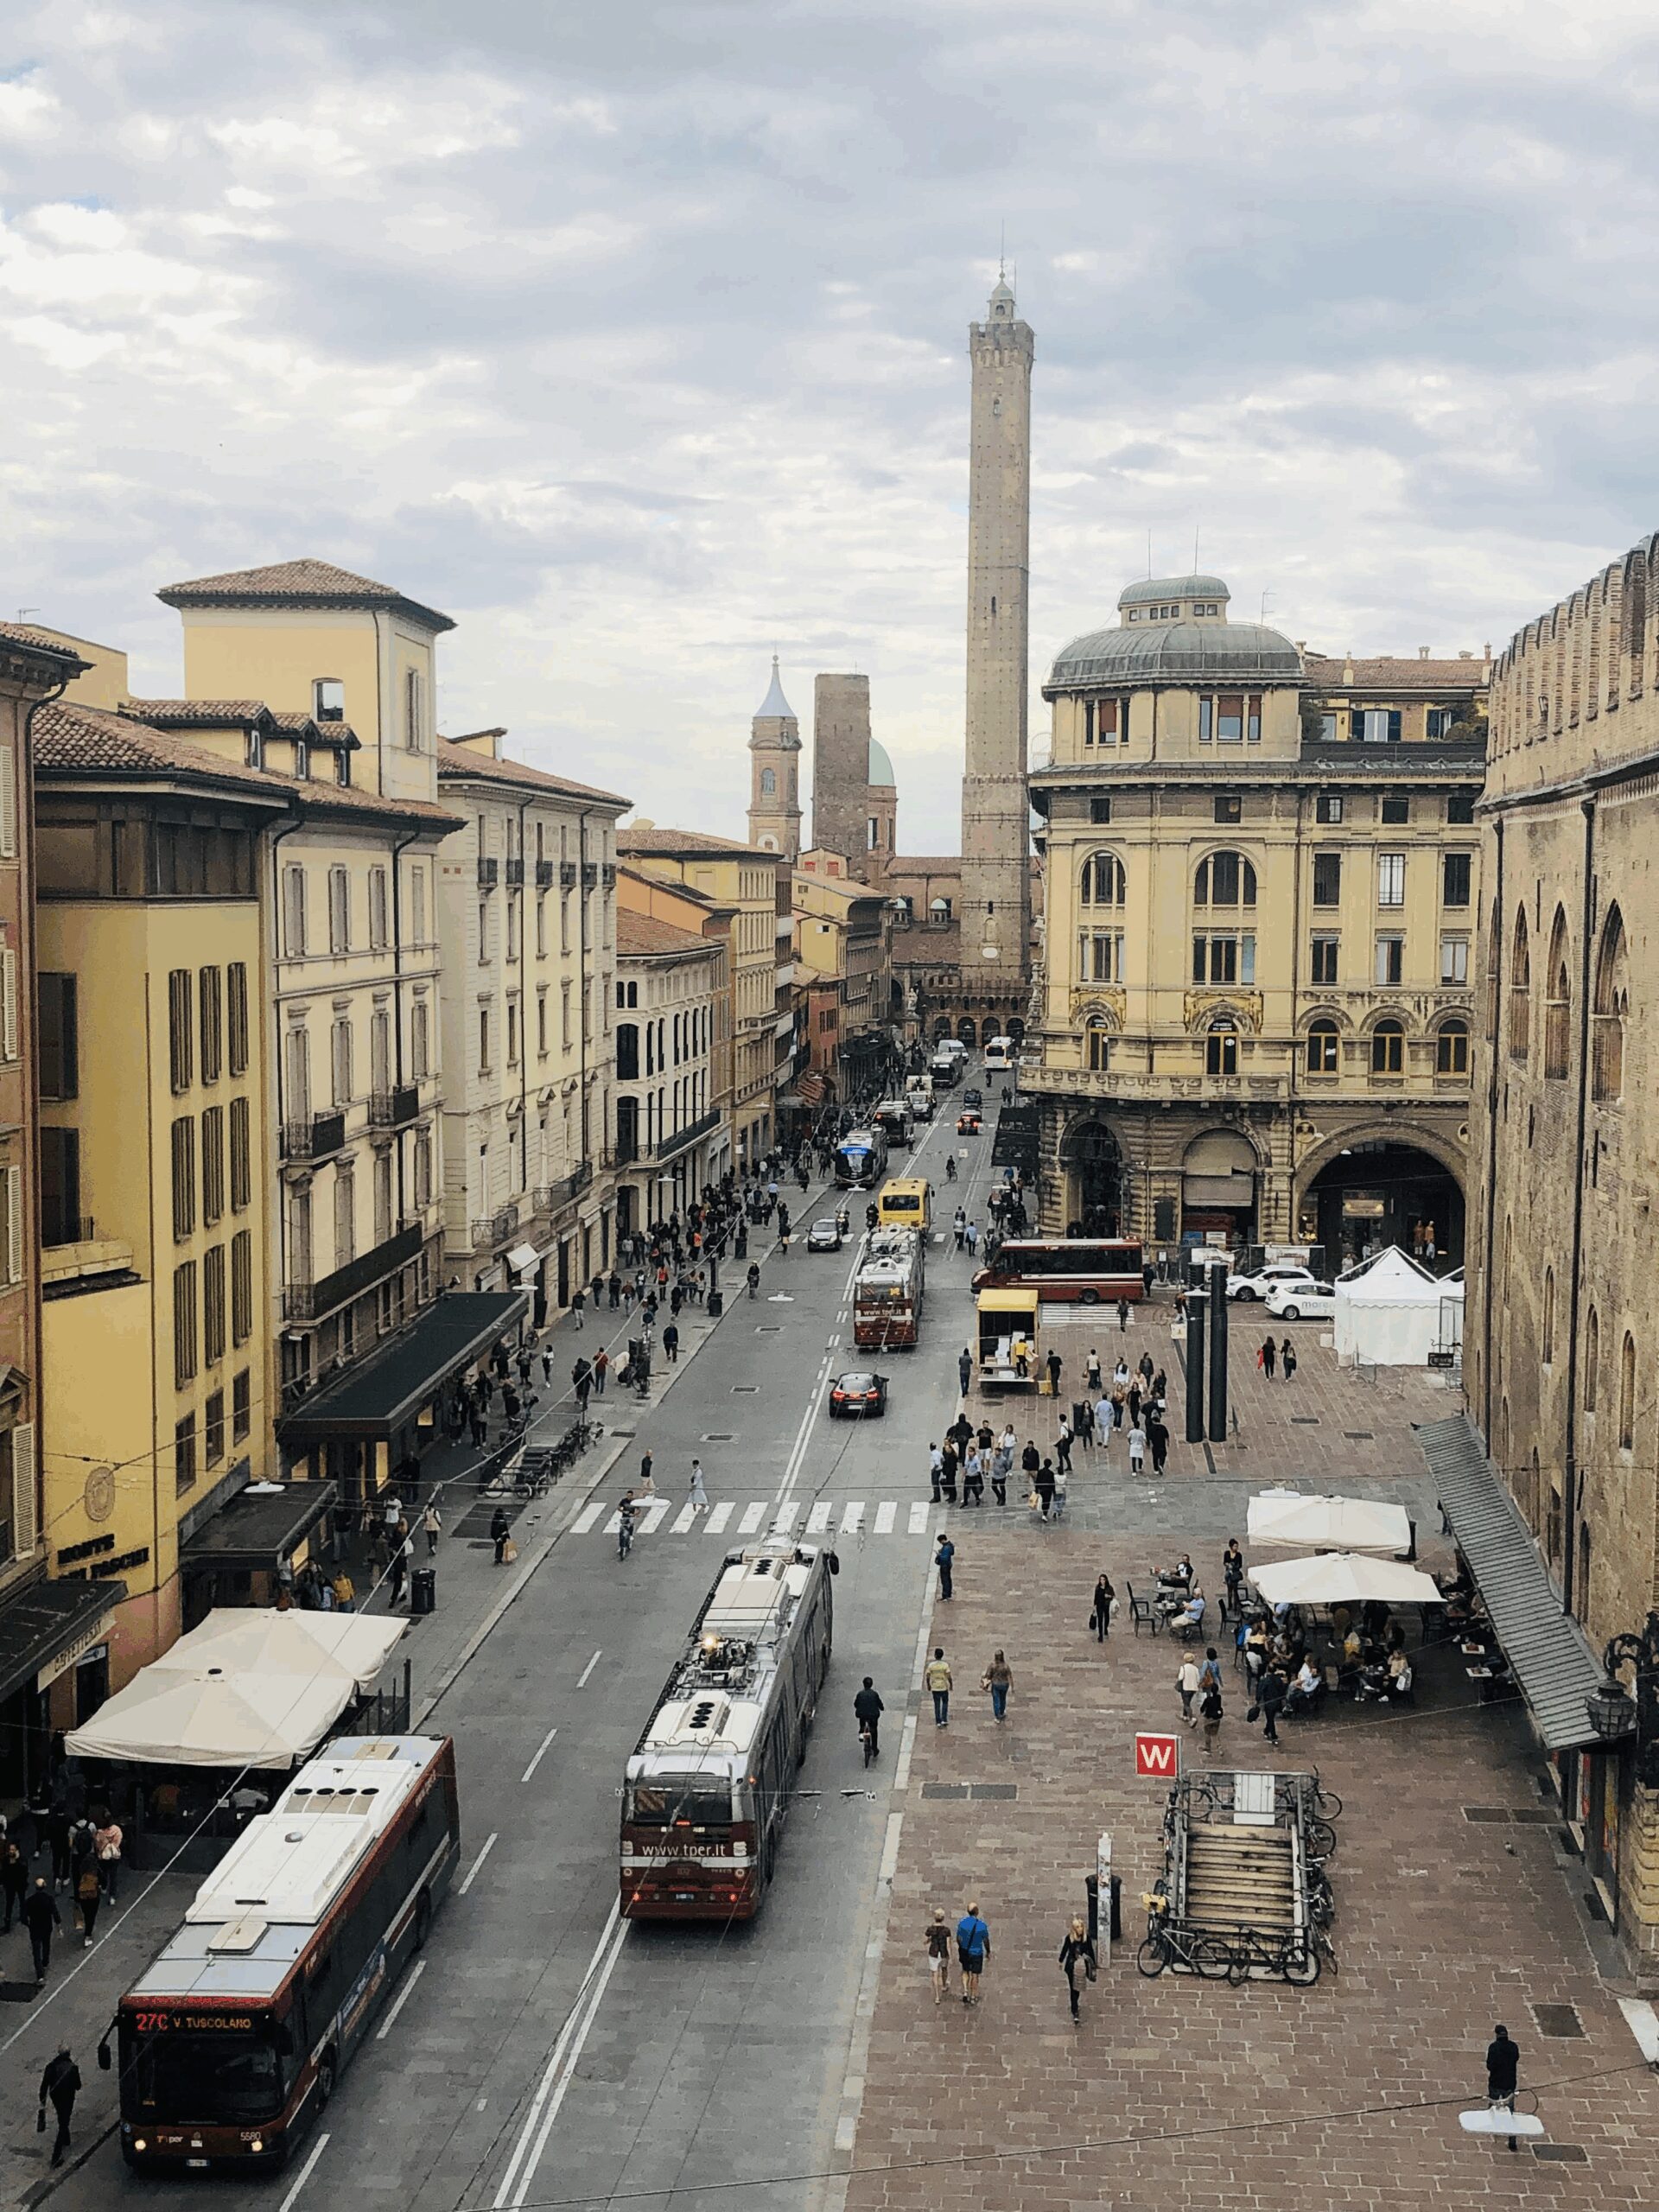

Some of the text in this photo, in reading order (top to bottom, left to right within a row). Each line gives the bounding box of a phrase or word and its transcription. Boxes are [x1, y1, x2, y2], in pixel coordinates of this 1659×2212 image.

[1140, 1744, 1172, 1770] W
[136, 2013, 168, 2031] 27C
[186, 2017, 251, 2029] TUSCOLANO
